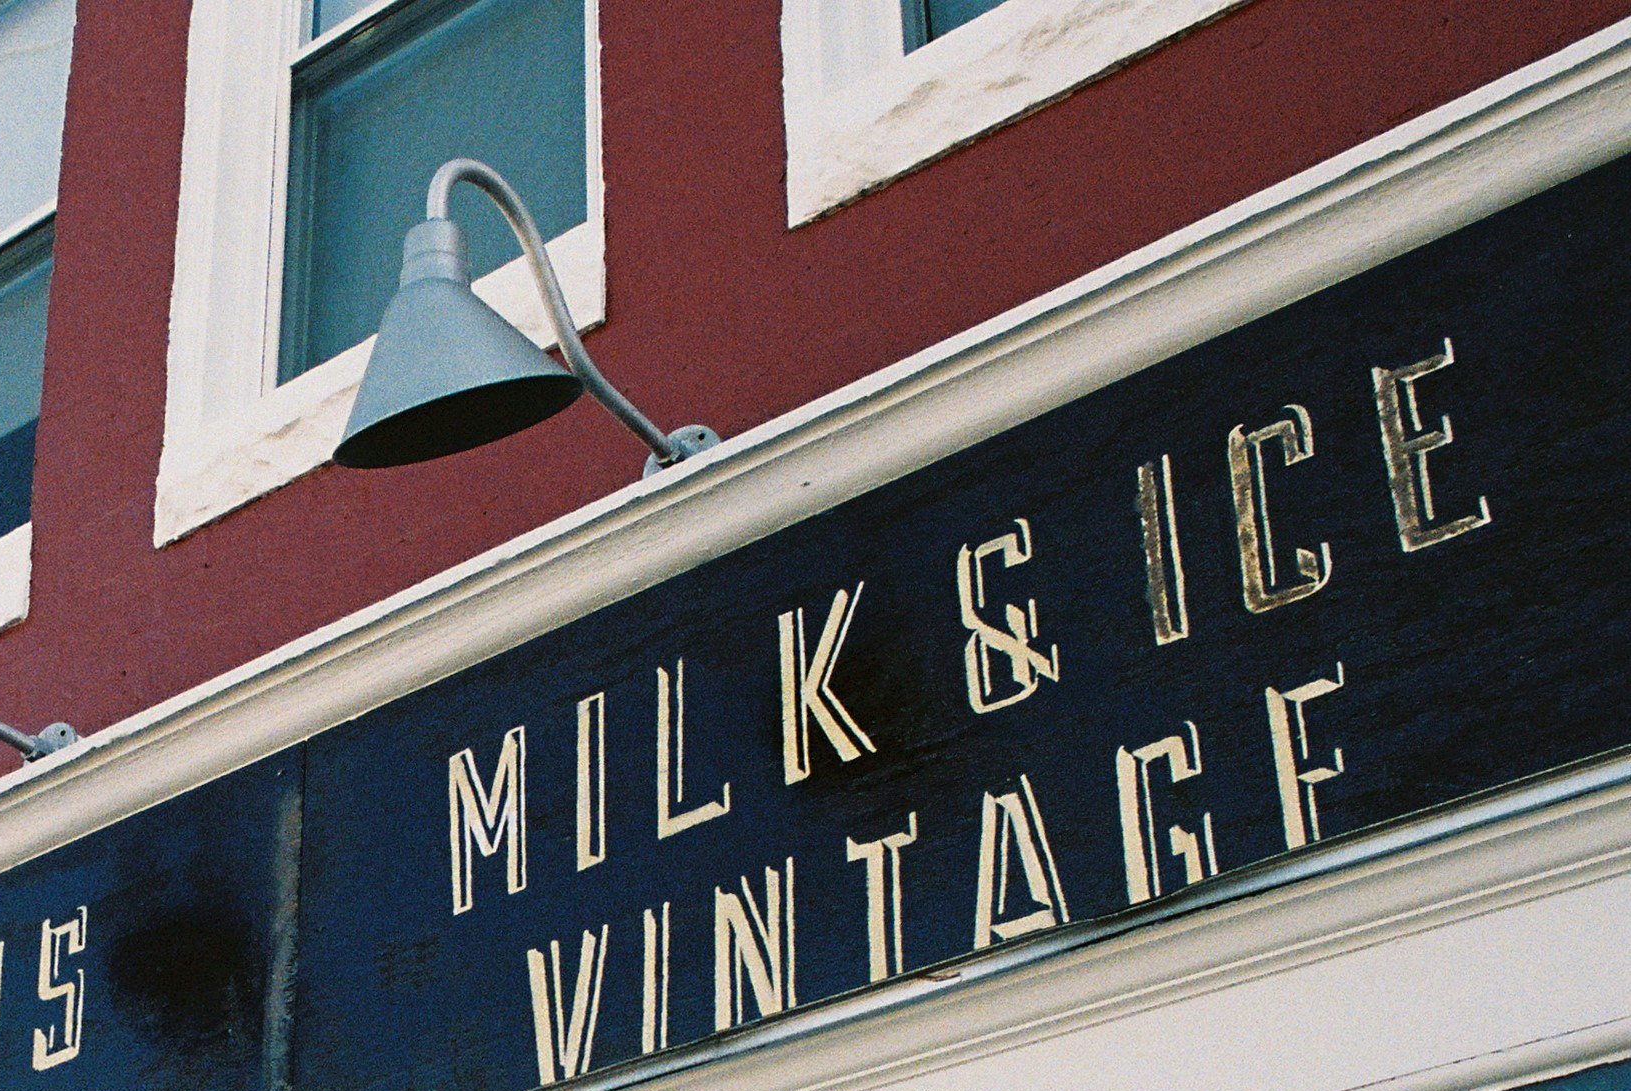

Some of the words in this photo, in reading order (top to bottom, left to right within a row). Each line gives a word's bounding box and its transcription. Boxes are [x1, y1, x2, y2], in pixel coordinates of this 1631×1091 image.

[448, 581, 877, 916] MILK
[955, 518, 1061, 714] &
[1136, 337, 1492, 646] ICE
[526, 661, 1346, 1087] VINTAGE
